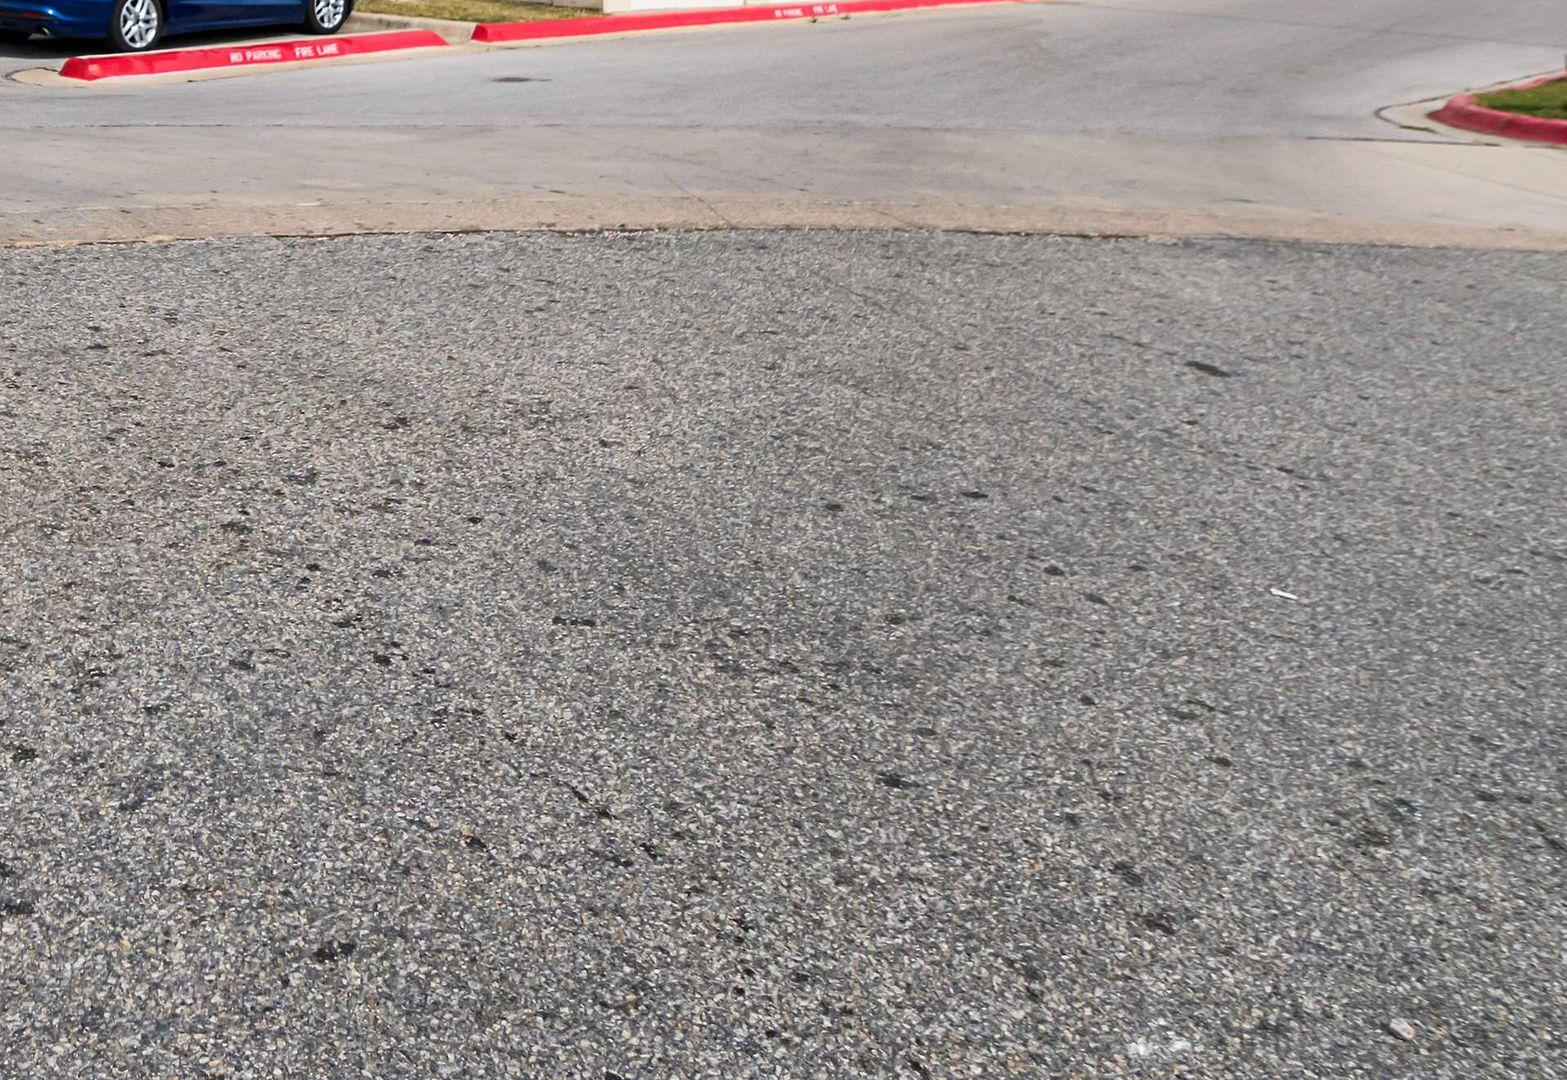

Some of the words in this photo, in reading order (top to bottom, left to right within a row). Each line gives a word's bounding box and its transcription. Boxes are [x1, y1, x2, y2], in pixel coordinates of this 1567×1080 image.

[230, 52, 243, 64] NO
[245, 49, 281, 61] PARKING
[294, 46, 314, 58] FIRE
